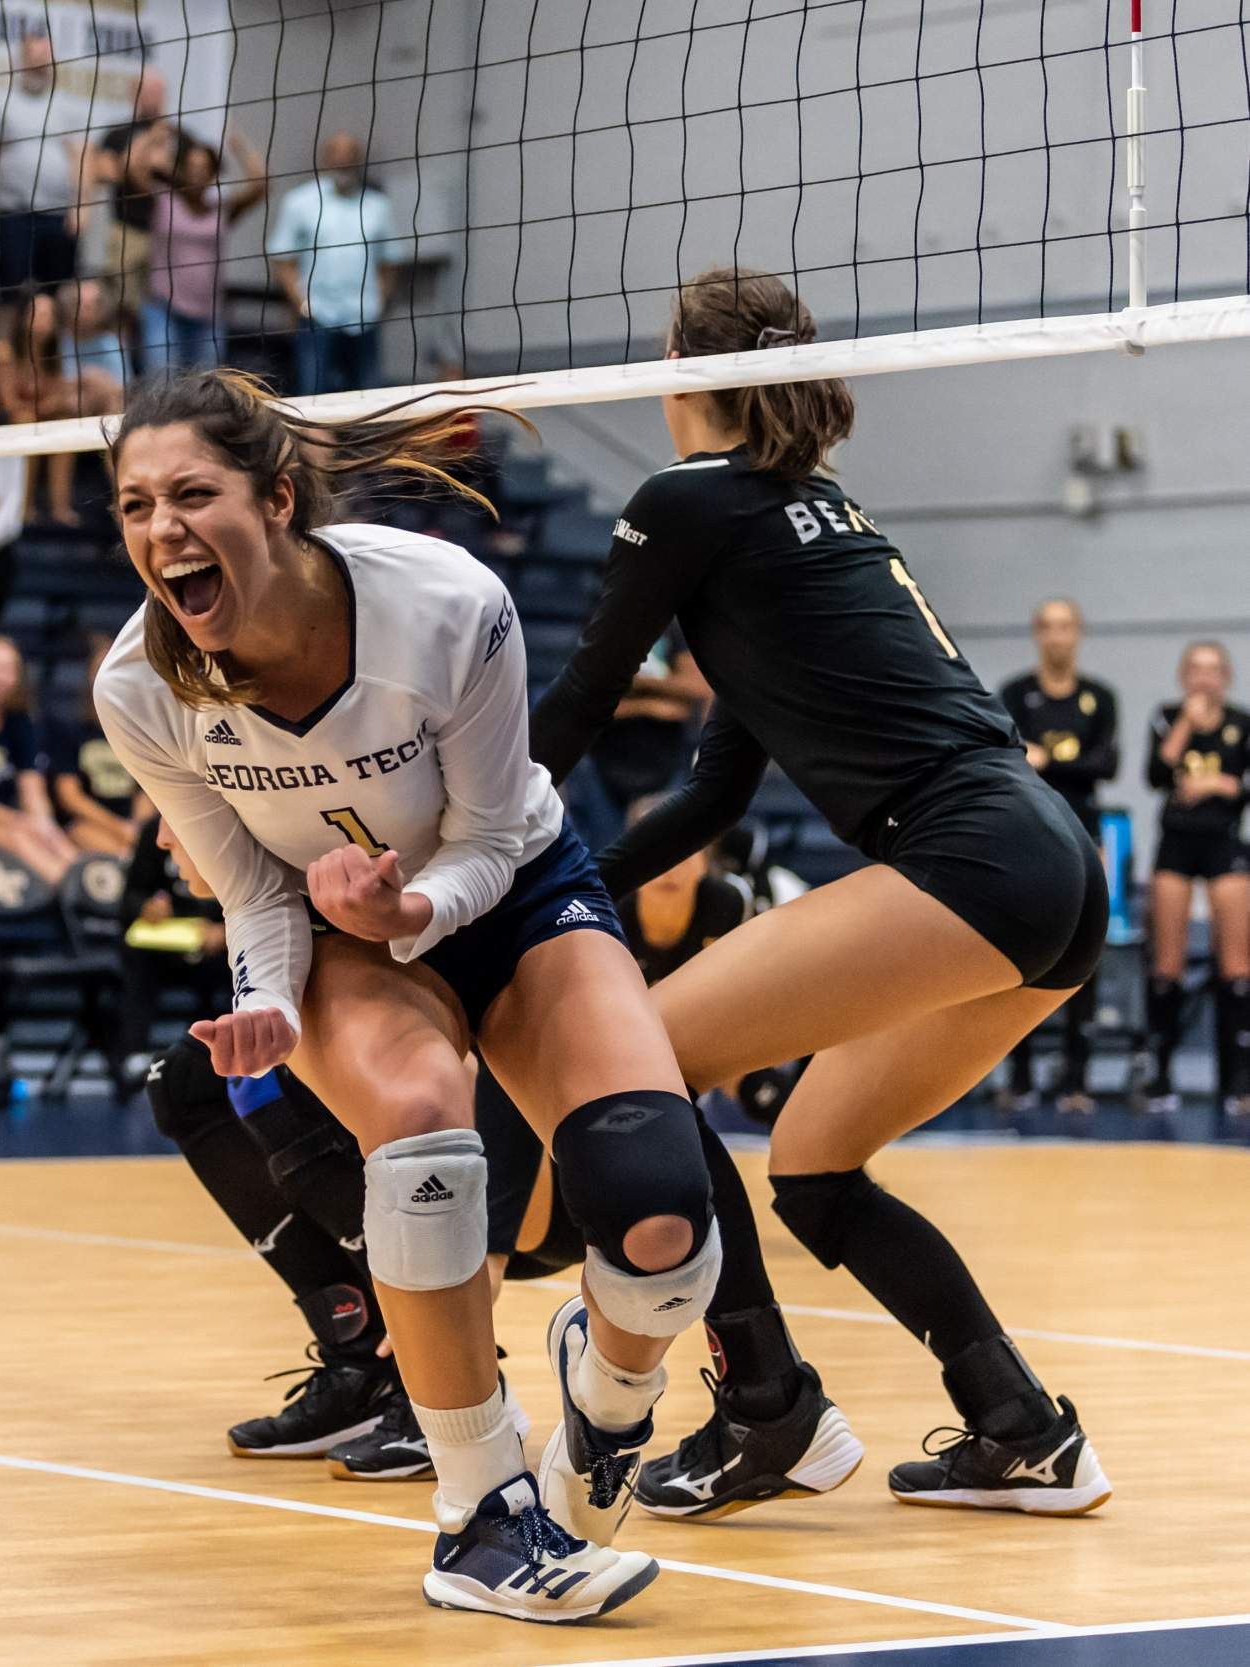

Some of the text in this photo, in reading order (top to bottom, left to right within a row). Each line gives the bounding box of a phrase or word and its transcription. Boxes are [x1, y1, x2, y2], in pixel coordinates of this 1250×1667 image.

[486, 592, 514, 656] ACC
[204, 733, 243, 746] adidas
[319, 806, 391, 858] 1
[411, 1189, 455, 1203] adidas
